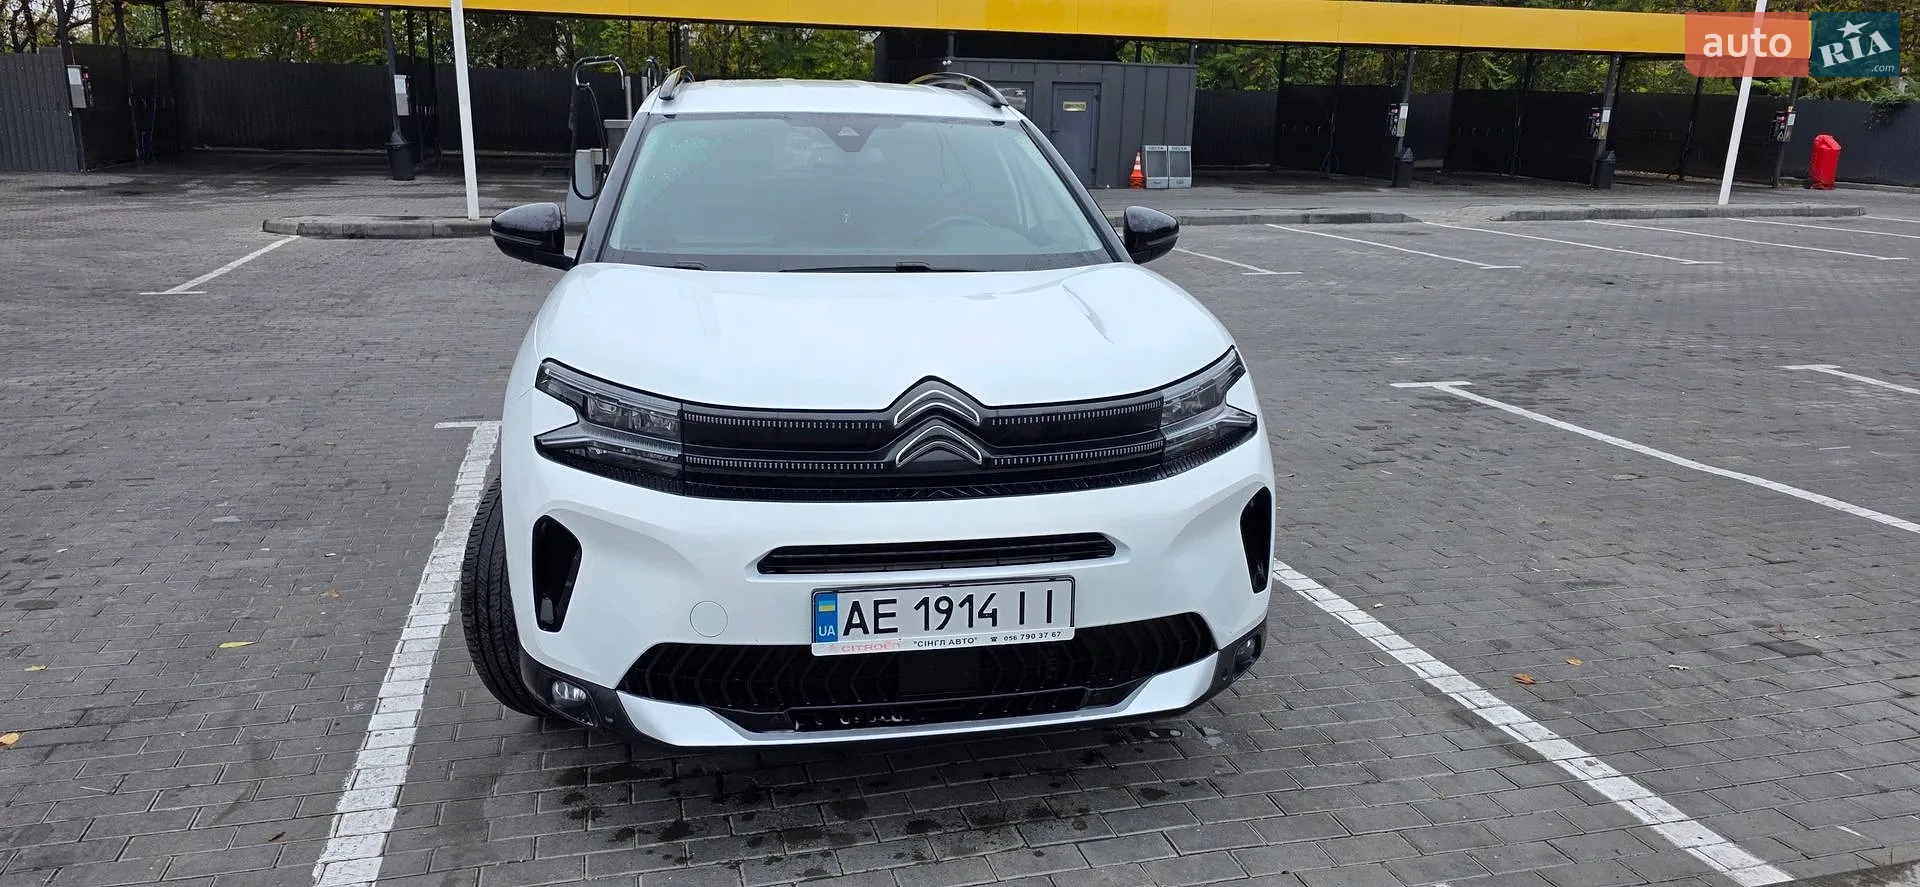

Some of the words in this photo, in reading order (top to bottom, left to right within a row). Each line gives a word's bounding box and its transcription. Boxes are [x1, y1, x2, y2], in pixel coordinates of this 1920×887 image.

[843, 598, 898, 636] AE
[913, 592, 998, 631] 1914
[818, 625, 836, 637] UA
[1020, 633, 1036, 641] 790
